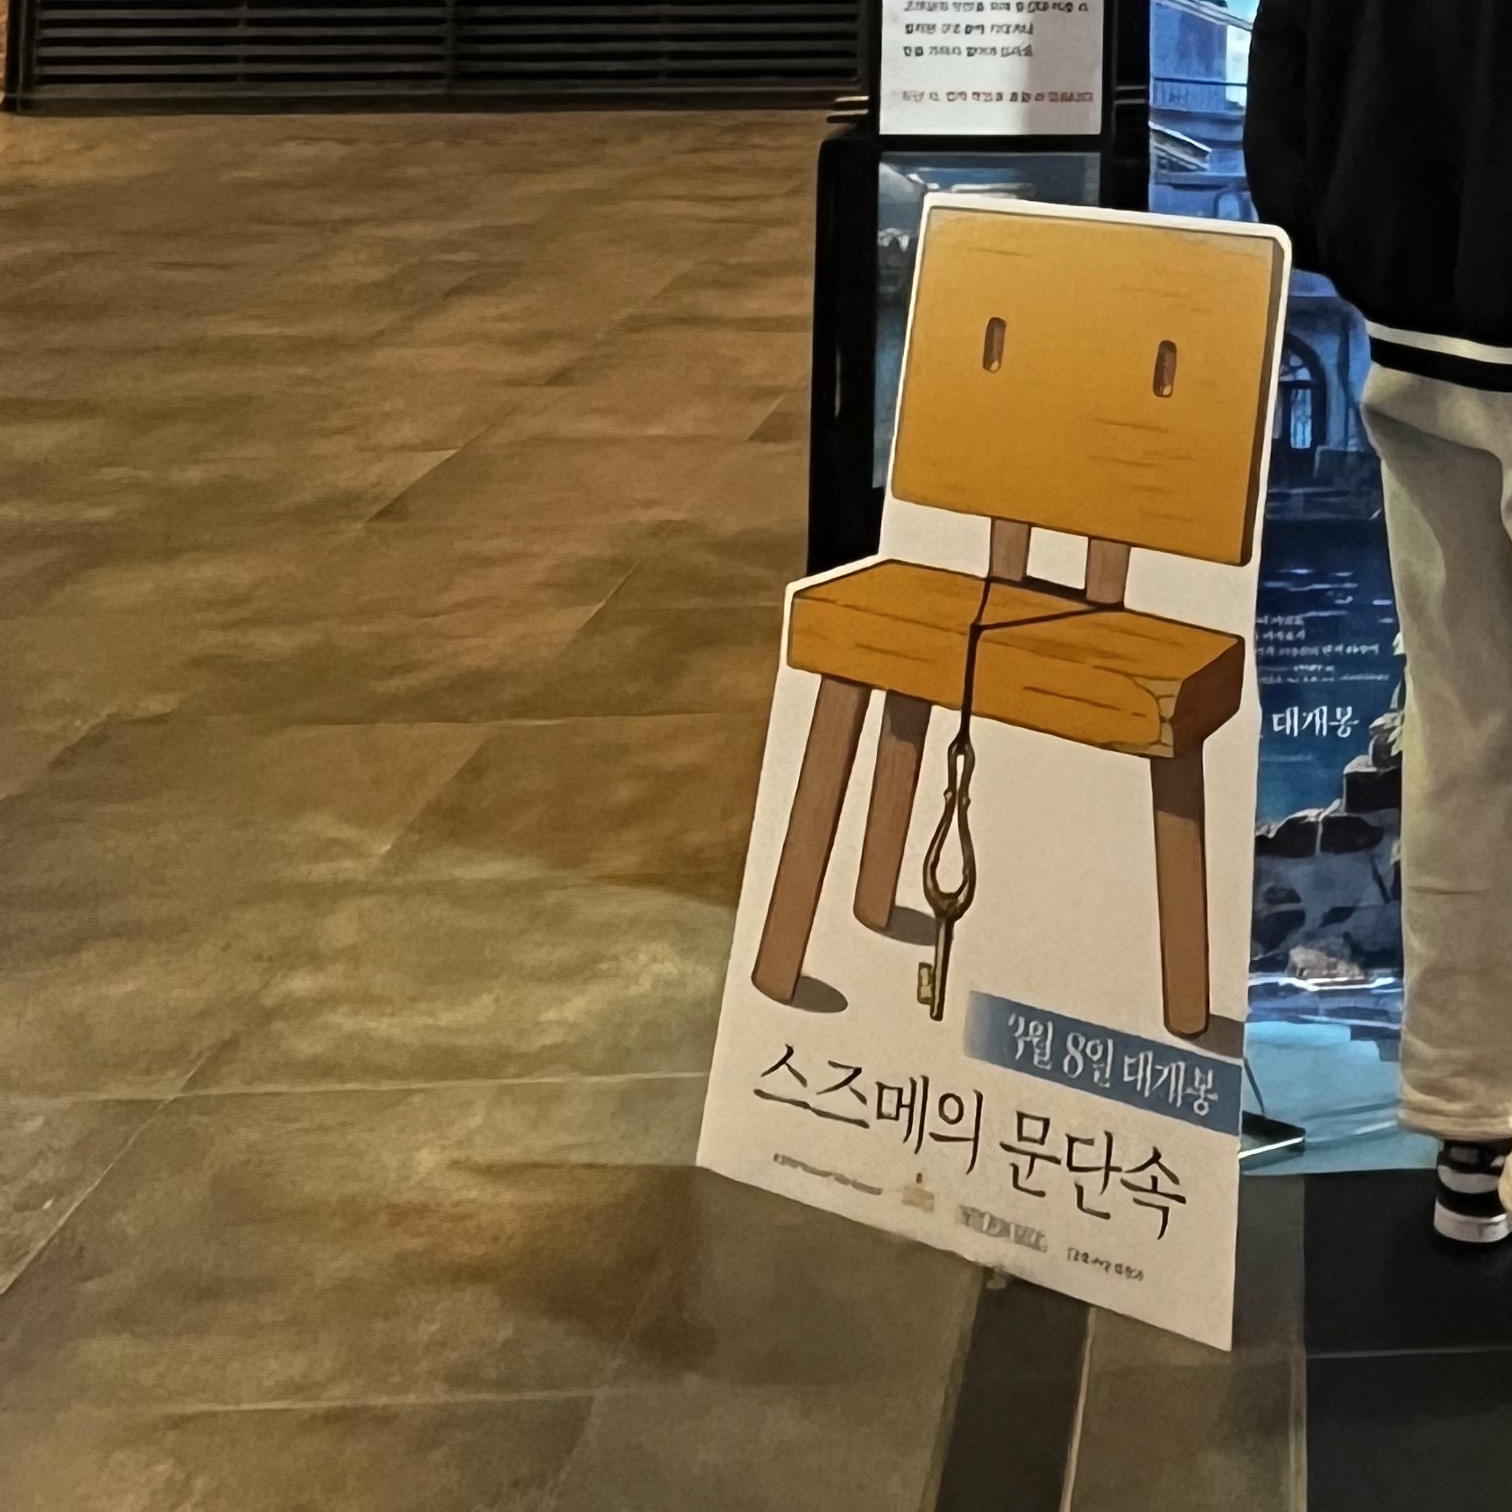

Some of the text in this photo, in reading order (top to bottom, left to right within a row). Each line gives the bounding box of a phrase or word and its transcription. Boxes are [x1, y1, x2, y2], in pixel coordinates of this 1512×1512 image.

[1271, 705, 1360, 738] 대개봉
[1063, 1032, 1114, 1088] 8일
[1123, 1050, 1219, 1116] 대개봉
[753, 1043, 1187, 1241] 스즈메의 문단속
